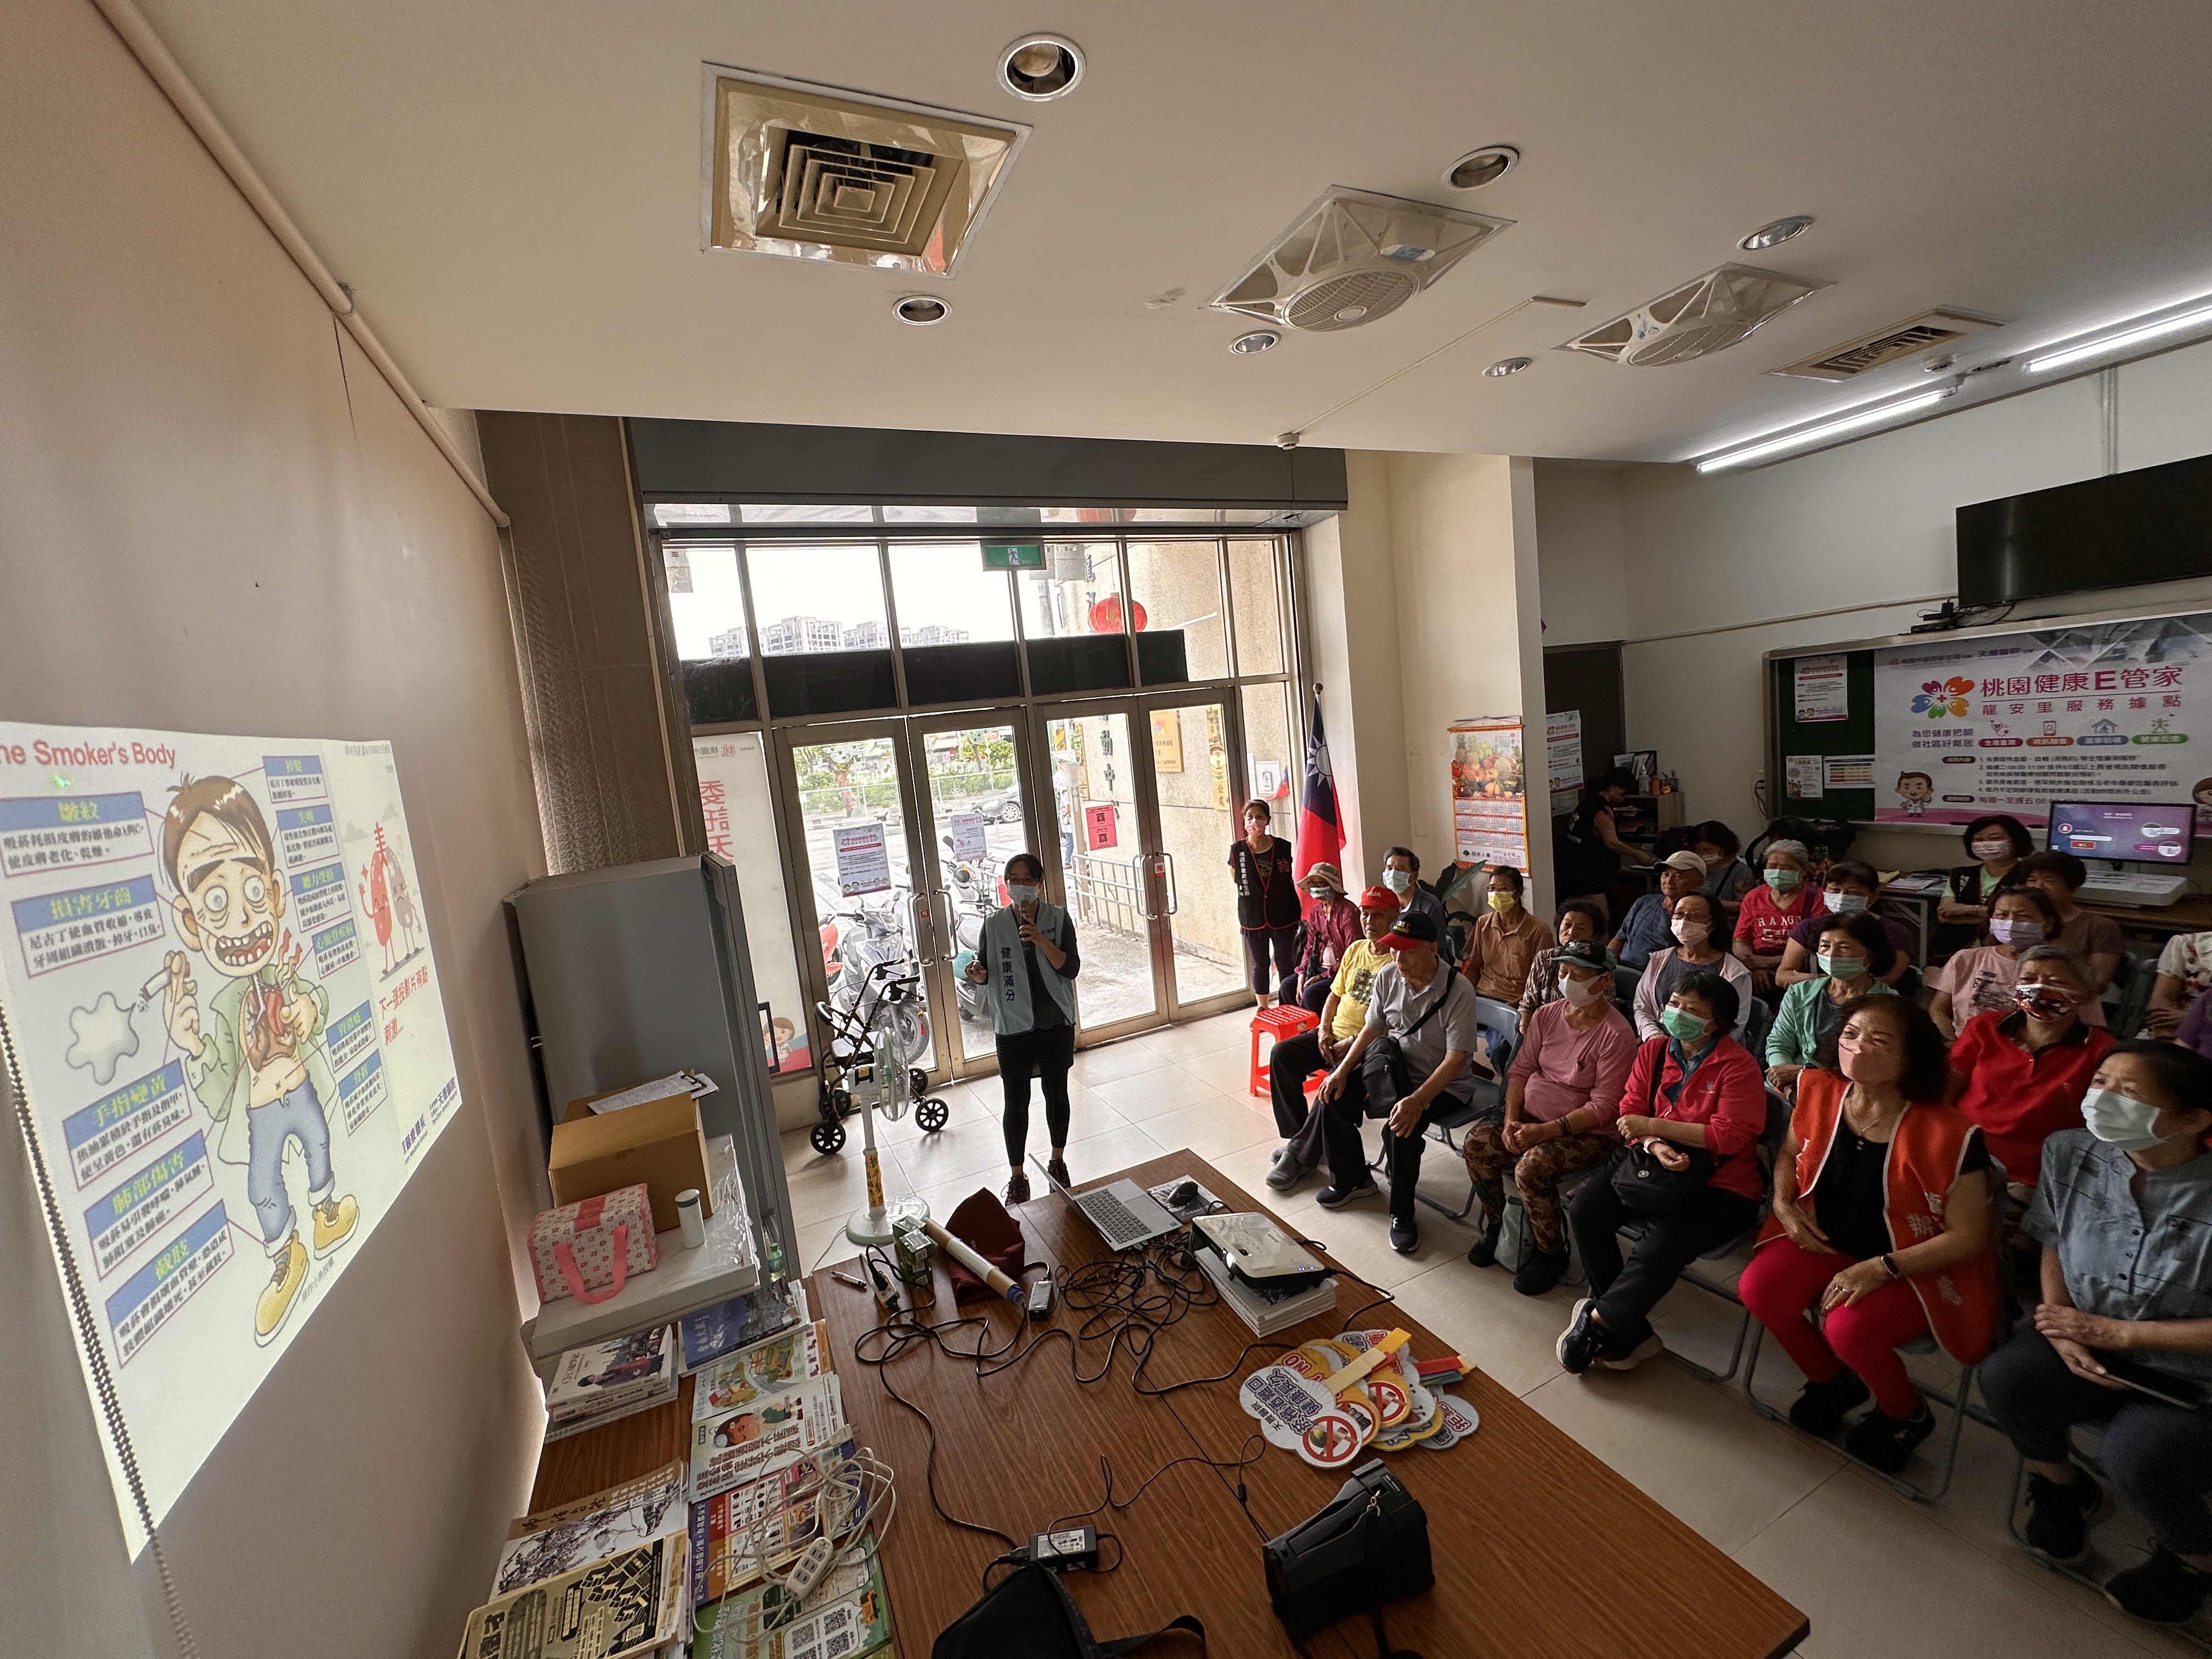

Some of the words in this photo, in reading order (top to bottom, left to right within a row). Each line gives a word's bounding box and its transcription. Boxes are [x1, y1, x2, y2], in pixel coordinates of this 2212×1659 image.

[1980, 665, 2183, 697] 桃園健康E管家
[1982, 694, 2182, 716] 龍安里服務據點
[1912, 728, 1973, 738] 為您健康把關
[1912, 739, 1973, 748] 做社區好鄰居
[33, 740, 129, 766] Smoker's
[132, 742, 176, 769] Body
[50, 887, 132, 921] 損害牙齒
[315, 922, 354, 950] 心血管疾病
[1001, 946, 1015, 1002] 健康滿分
[379, 965, 429, 1021] 下一張投影片有點
[94, 1074, 166, 1127] 手指變黃
[112, 1150, 184, 1215] 肺部傷害
[155, 1238, 190, 1281] 截肢
[1267, 1368, 1323, 1417] 健康長久
[708, 1423, 800, 1468] 就醫通報不延誤
[734, 1437, 802, 1471] 症狀不輕忽
[696, 1460, 733, 1480] 屈公病
[696, 1471, 733, 1491] 登革熱
